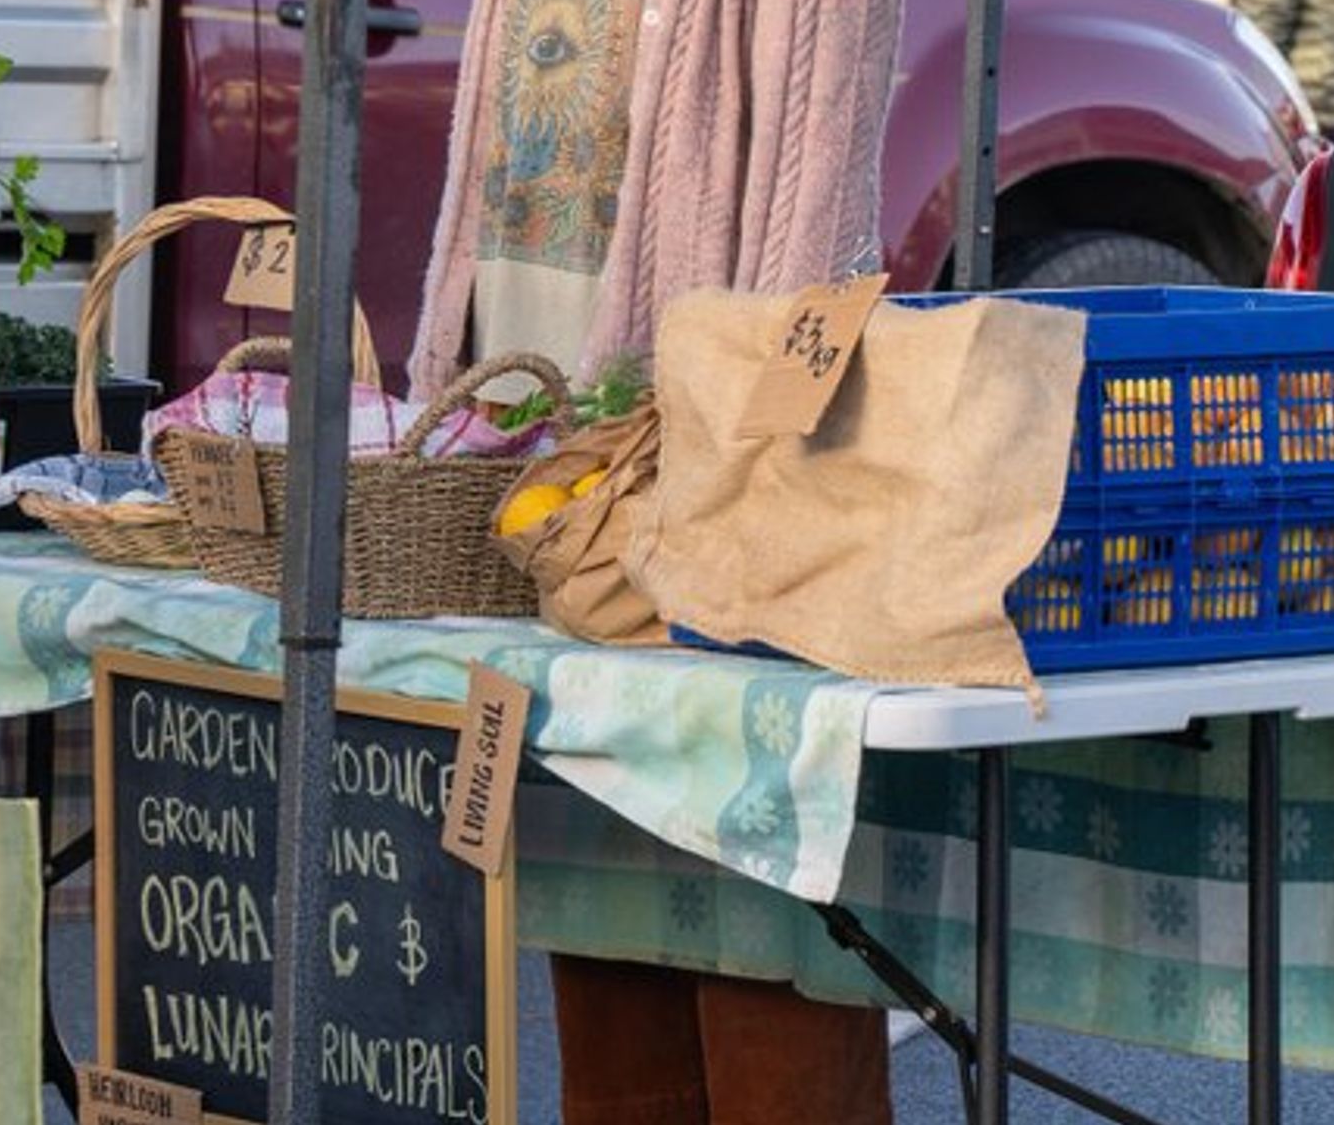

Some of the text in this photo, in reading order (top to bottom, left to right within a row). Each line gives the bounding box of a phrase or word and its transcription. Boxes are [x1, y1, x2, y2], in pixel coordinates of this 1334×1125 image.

[242, 234, 290, 277] $2
[131, 690, 278, 782] GARDEN
[138, 795, 257, 859] GROWN
[459, 762, 494, 848] LIVING
